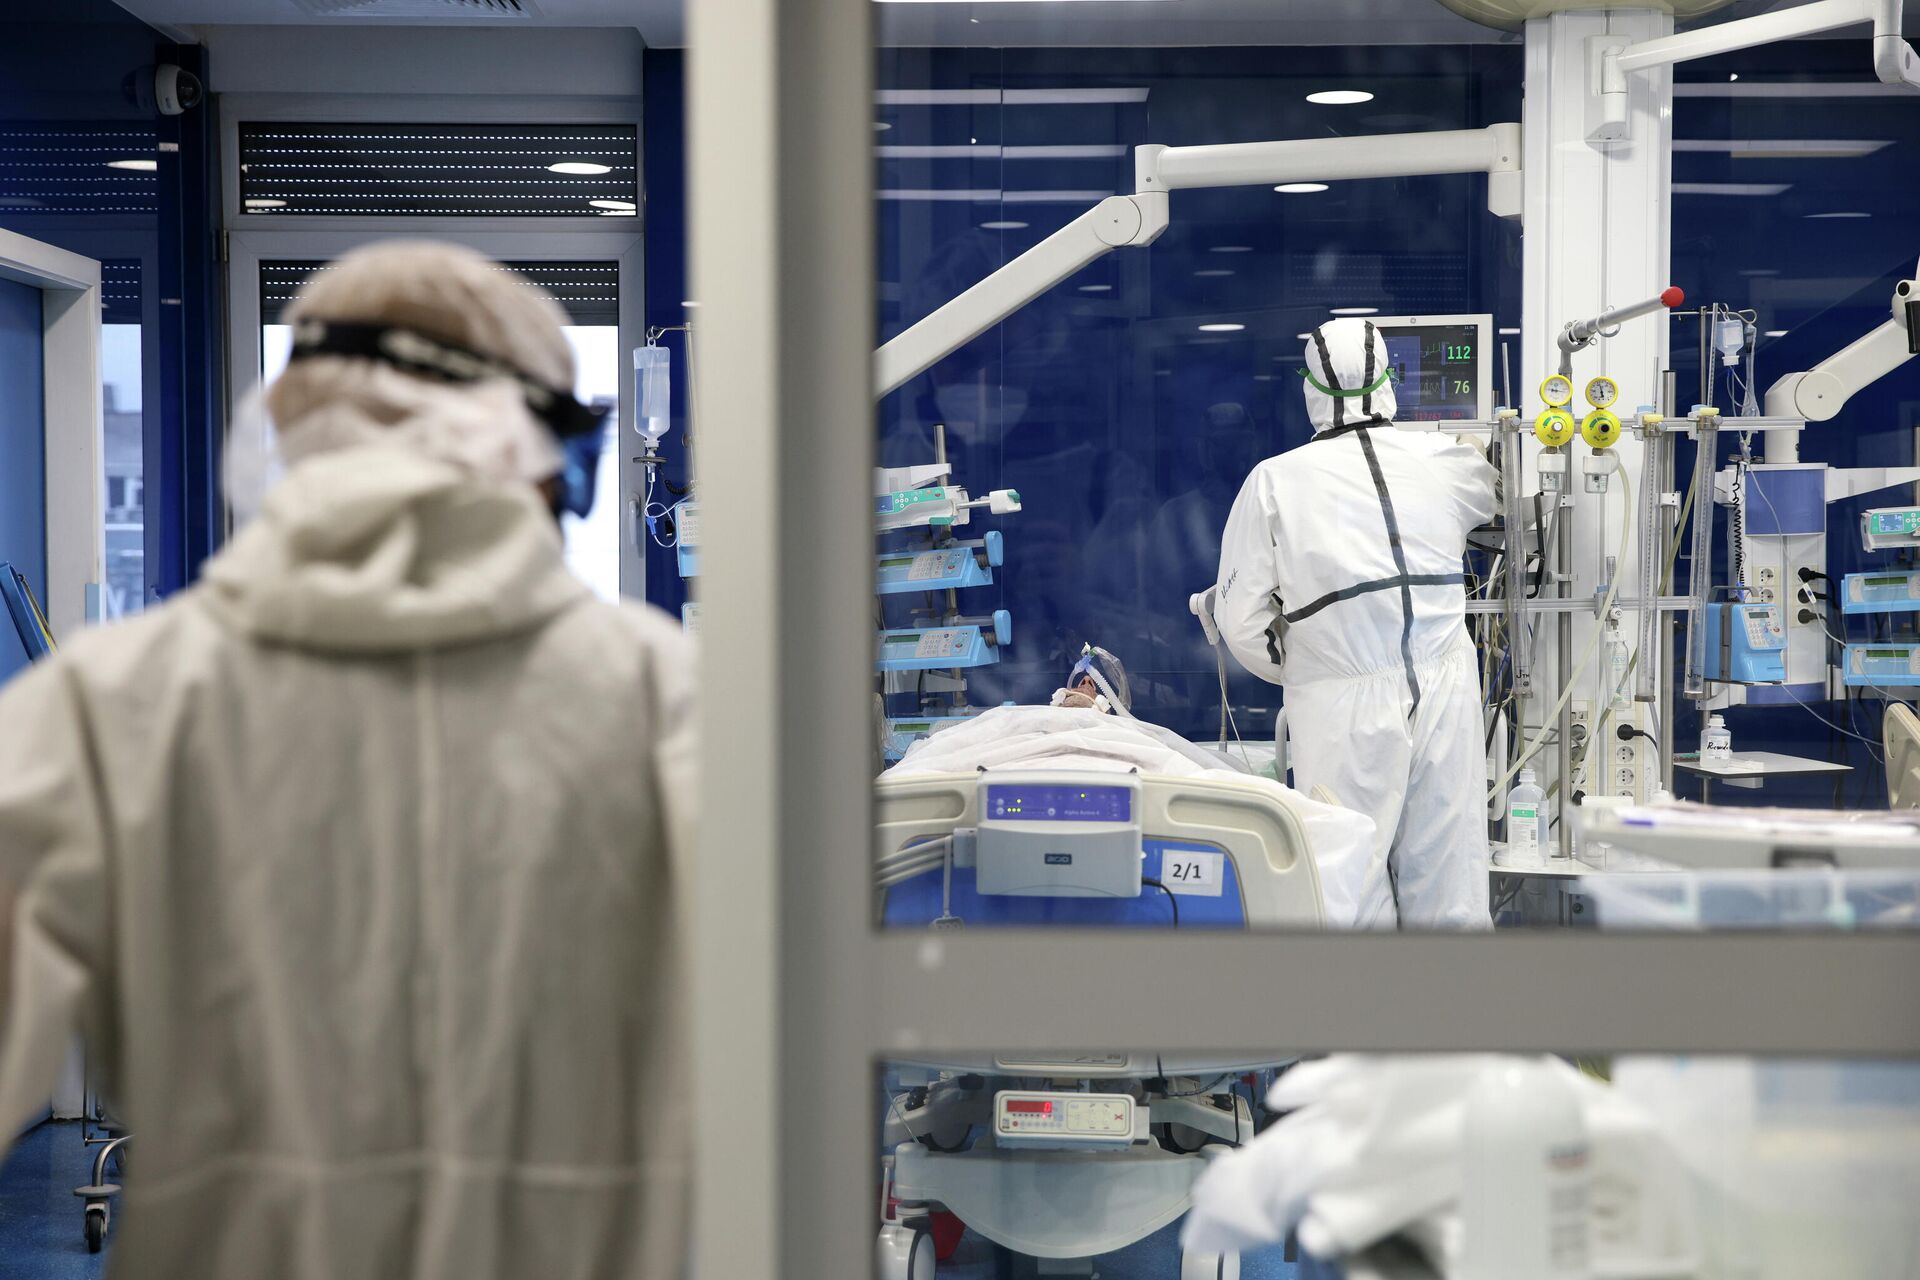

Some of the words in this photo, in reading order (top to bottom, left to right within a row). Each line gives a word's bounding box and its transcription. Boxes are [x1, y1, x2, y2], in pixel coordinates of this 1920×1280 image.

[1447, 345, 1471, 360] 112
[1454, 380, 1470, 394] 76
[1172, 863, 1202, 881] 2/1
